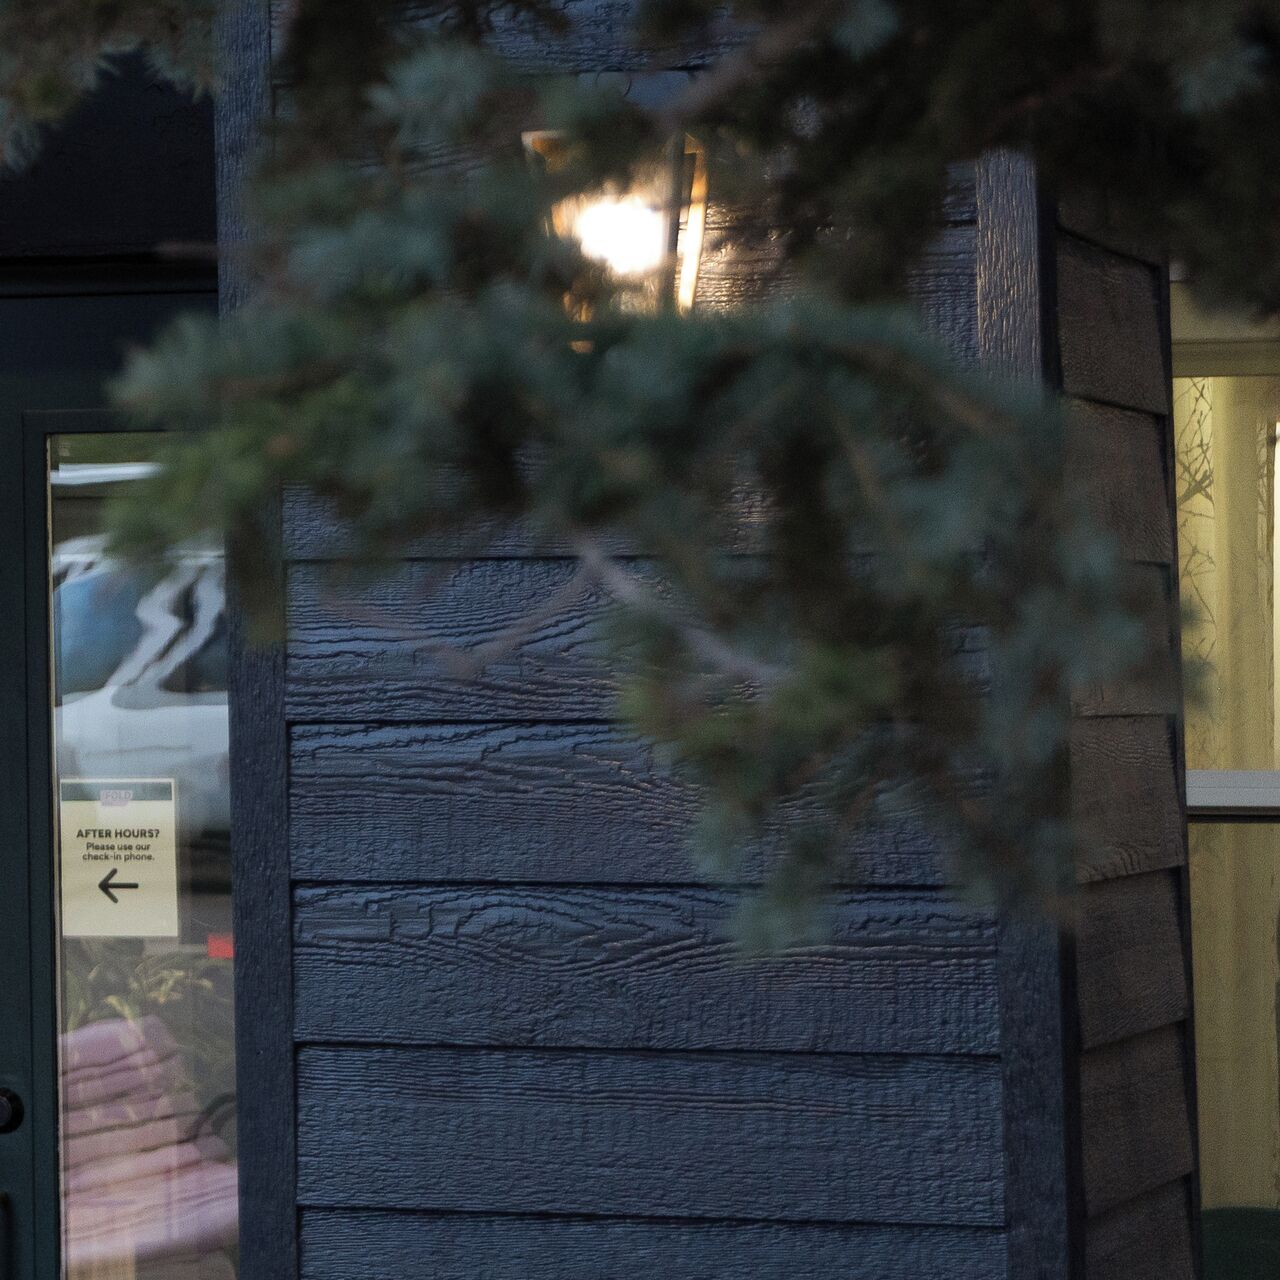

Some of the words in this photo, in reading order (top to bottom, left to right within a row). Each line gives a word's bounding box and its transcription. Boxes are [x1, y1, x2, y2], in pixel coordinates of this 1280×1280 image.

[76, 828, 112, 838] AFTER
[114, 828, 160, 838] HOURS?
[86, 841, 116, 851] Please
[82, 852, 122, 861] check-in
[123, 852, 155, 862] phone.
